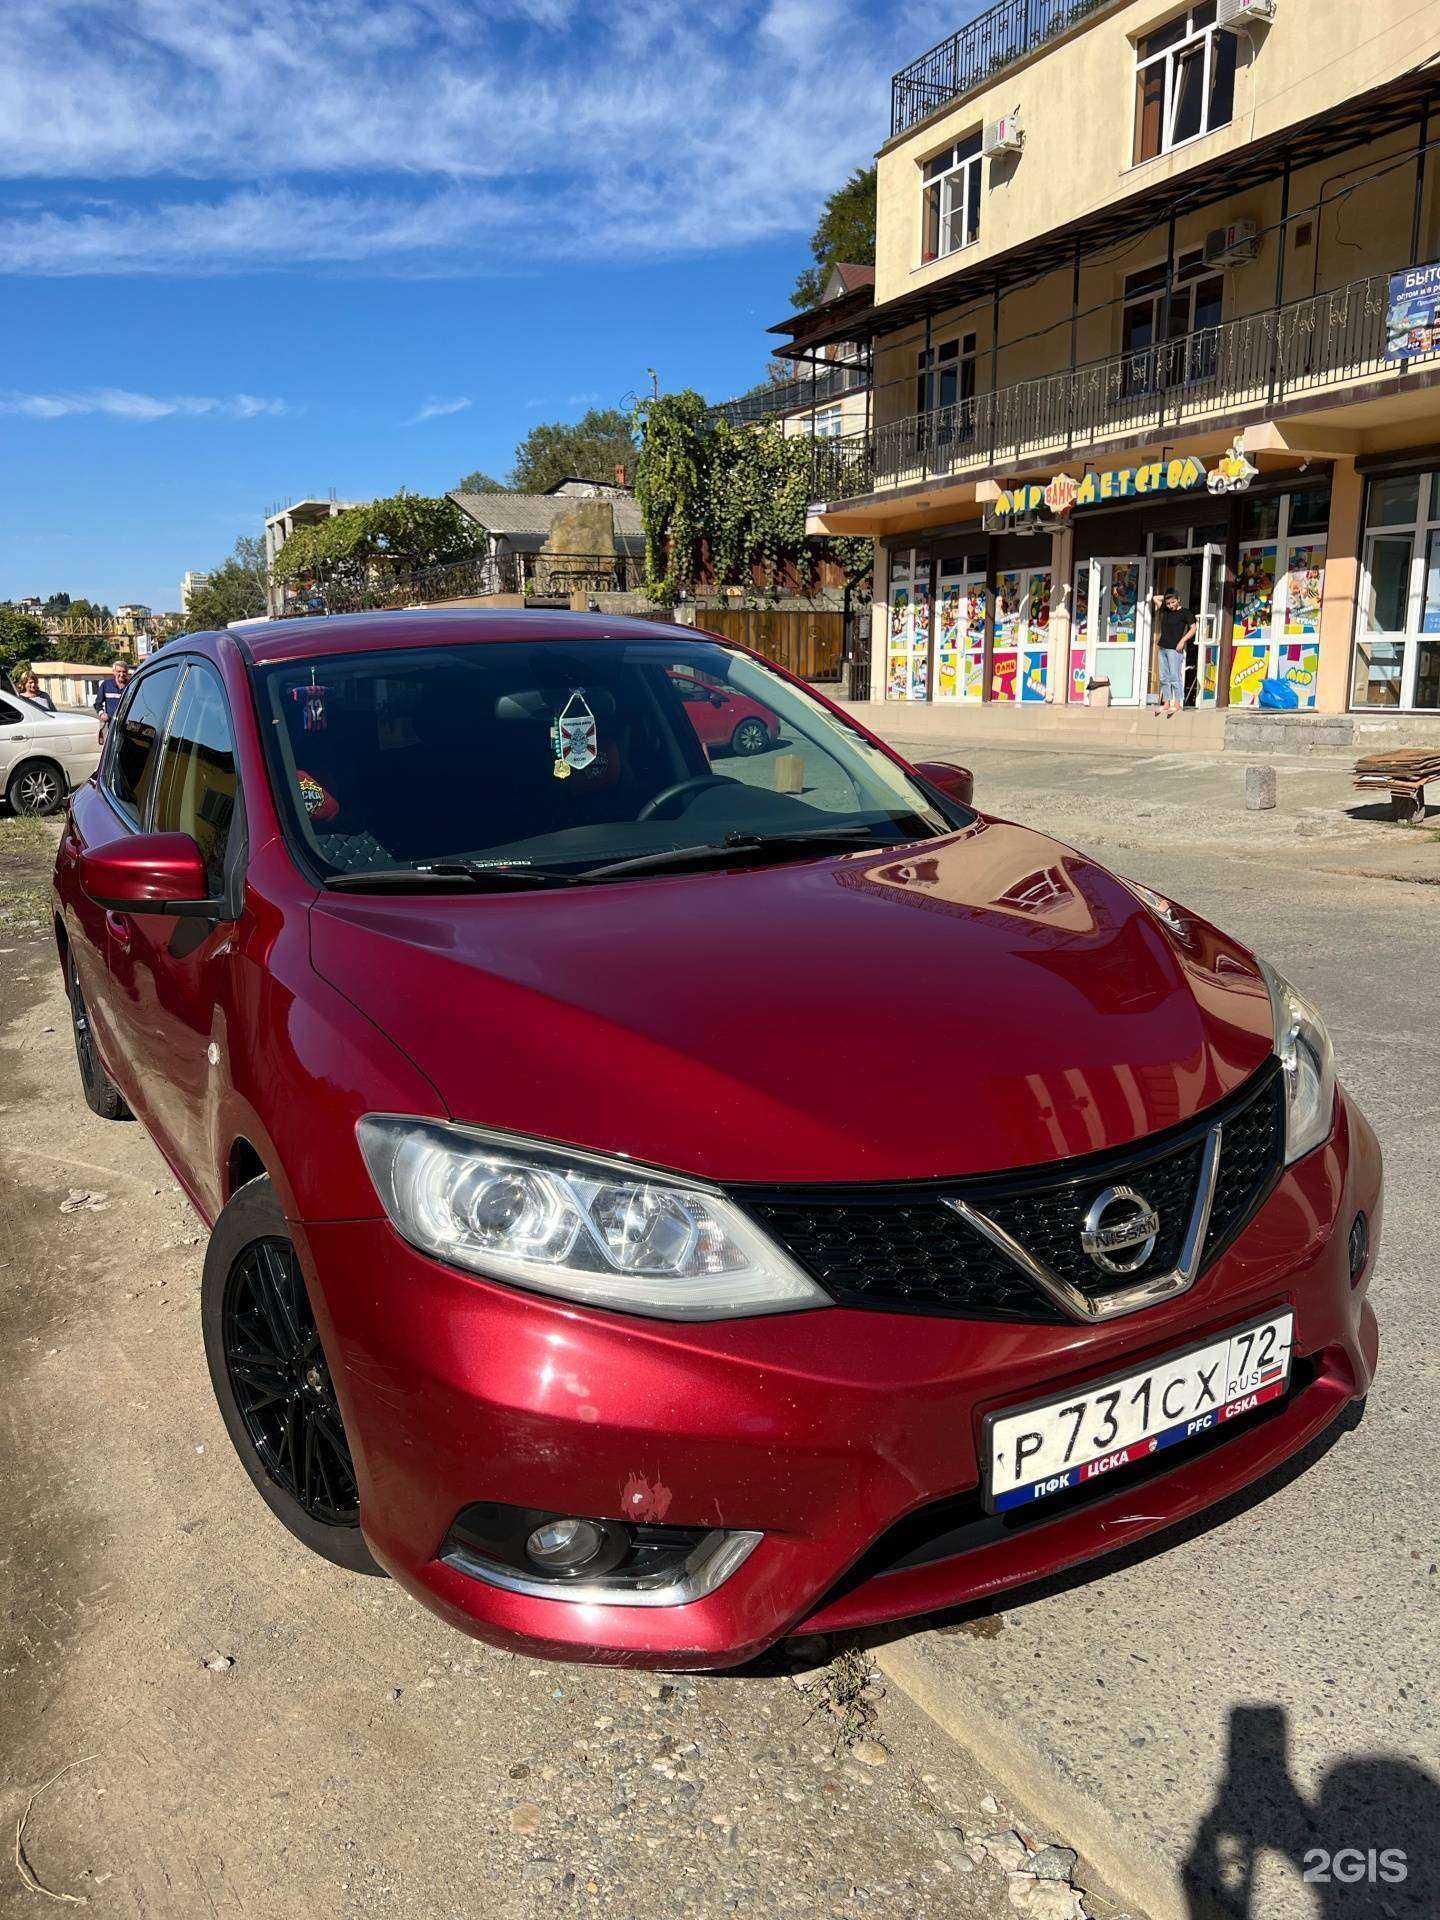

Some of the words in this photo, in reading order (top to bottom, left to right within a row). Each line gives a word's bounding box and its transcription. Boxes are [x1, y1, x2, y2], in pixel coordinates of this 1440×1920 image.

[994, 485, 1042, 517] МИР
[1077, 457, 1203, 504] ДЕТСТВА
[1096, 1216, 1159, 1249] NISSAN
[1237, 1325, 1277, 1376] 72
[1227, 1370, 1262, 1397] RUS
[1186, 1413, 1213, 1436] PFC
[1225, 1395, 1259, 1418] CSKA
[1034, 1473, 1070, 1499] ПФК
[1087, 1450, 1130, 1478] ЦСКА
